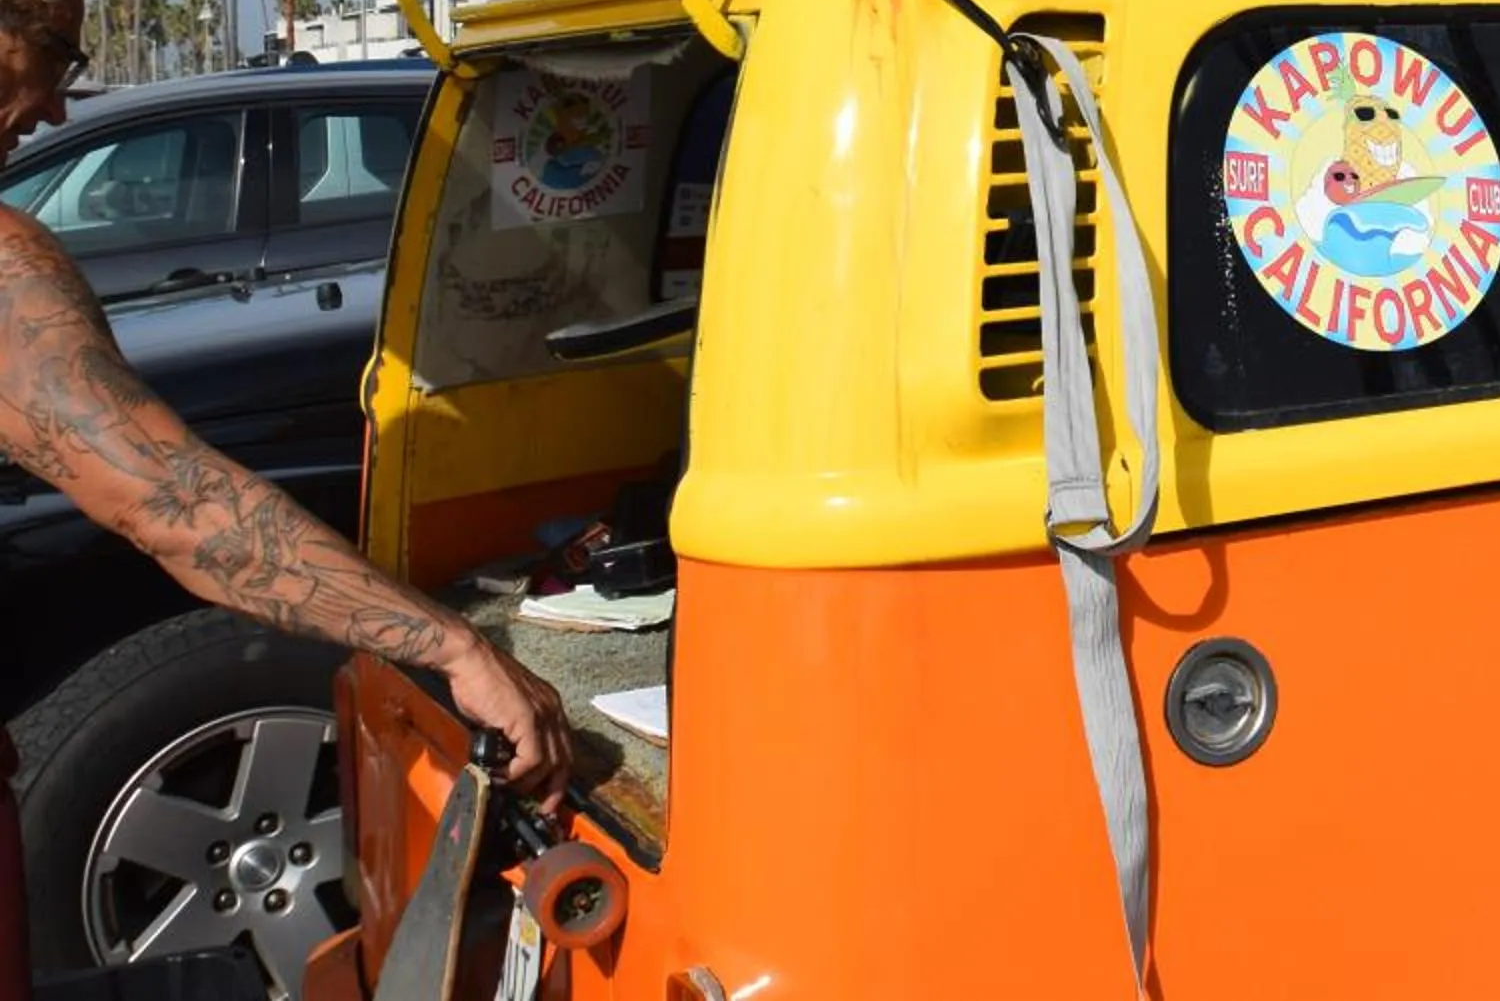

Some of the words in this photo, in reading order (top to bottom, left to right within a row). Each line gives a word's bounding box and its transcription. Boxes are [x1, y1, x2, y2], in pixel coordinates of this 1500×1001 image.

[1244, 39, 1487, 156] KAPOWUI
[511, 163, 631, 218] CALIFORNIA
[1228, 158, 1266, 193] SURF
